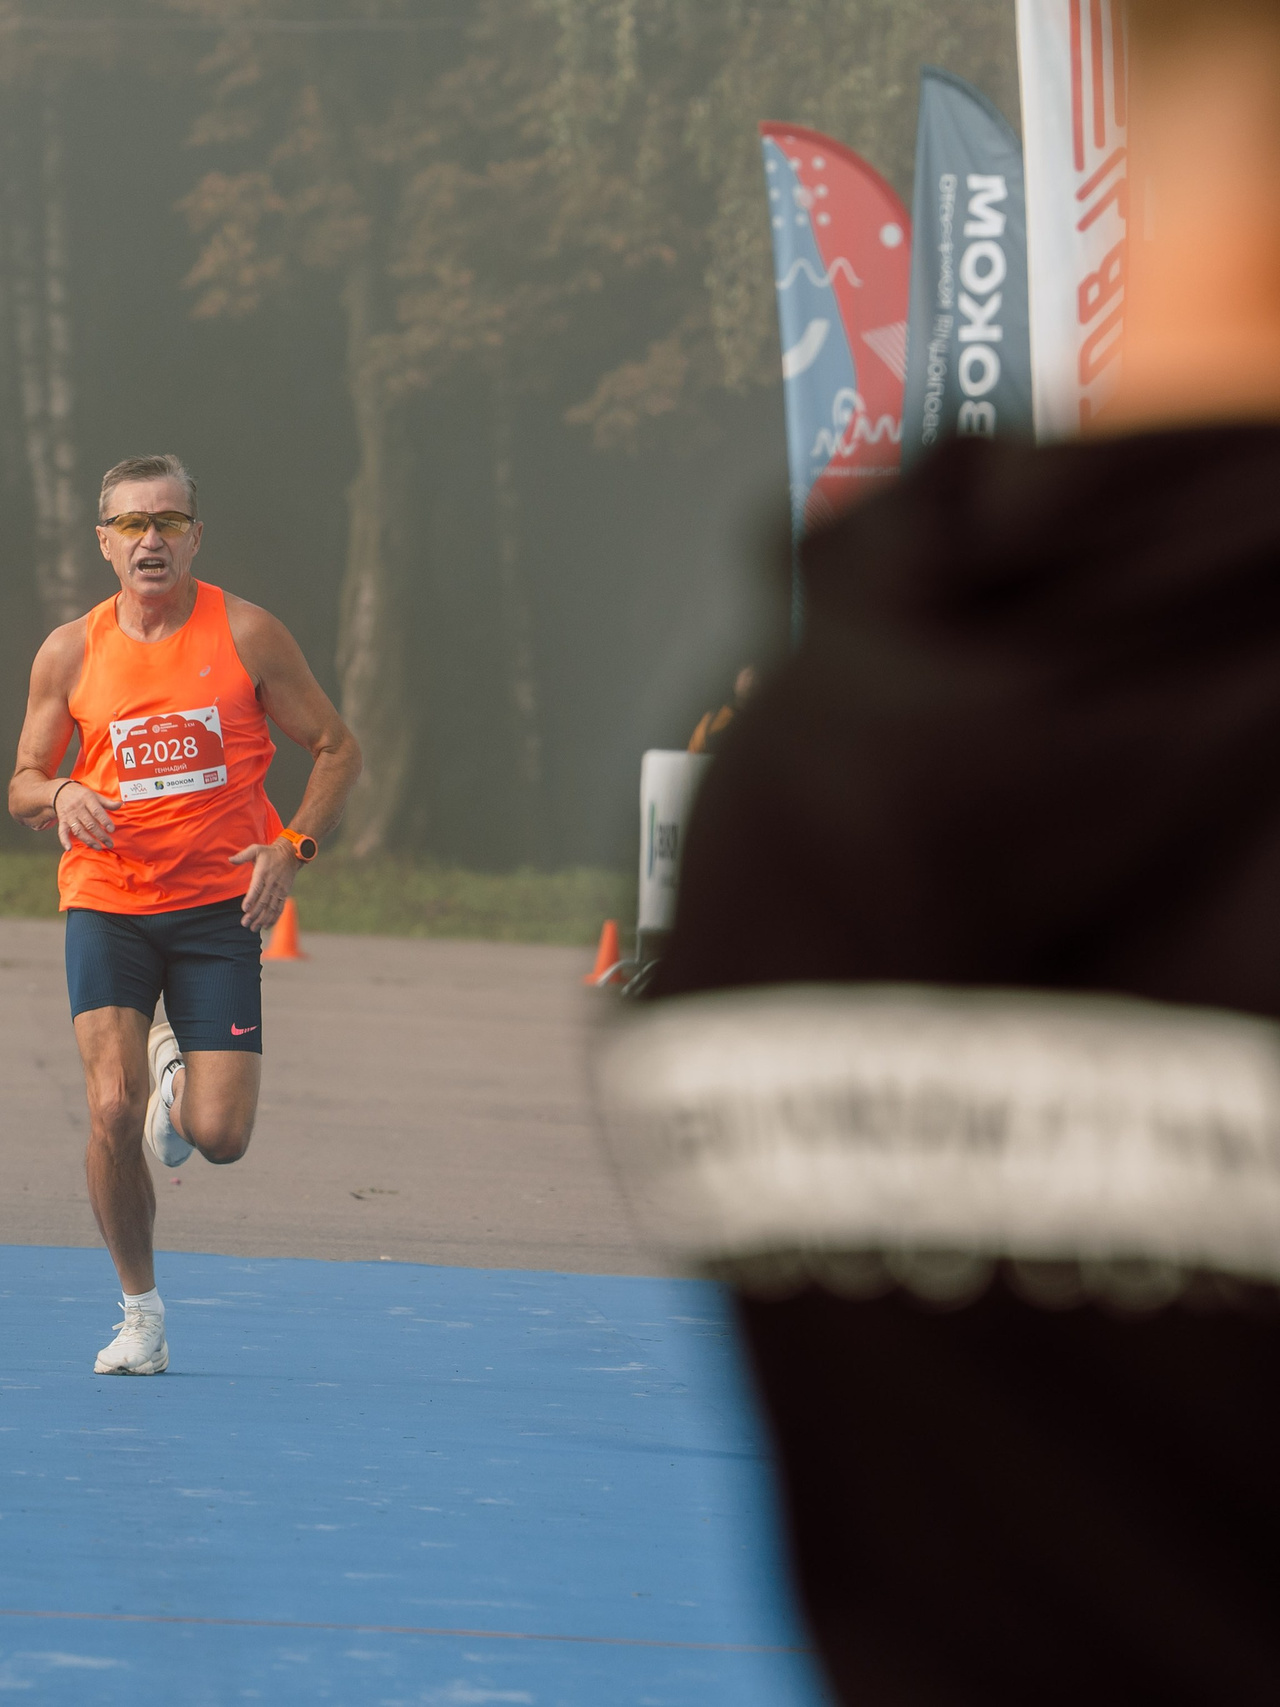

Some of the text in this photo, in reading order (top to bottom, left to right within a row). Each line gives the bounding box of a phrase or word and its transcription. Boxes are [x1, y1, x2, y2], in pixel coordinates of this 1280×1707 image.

[138, 736, 199, 765] 2028
[154, 763, 188, 774] ГЕННАДИЙ
[166, 778, 195, 787] ЭВОКОМ
